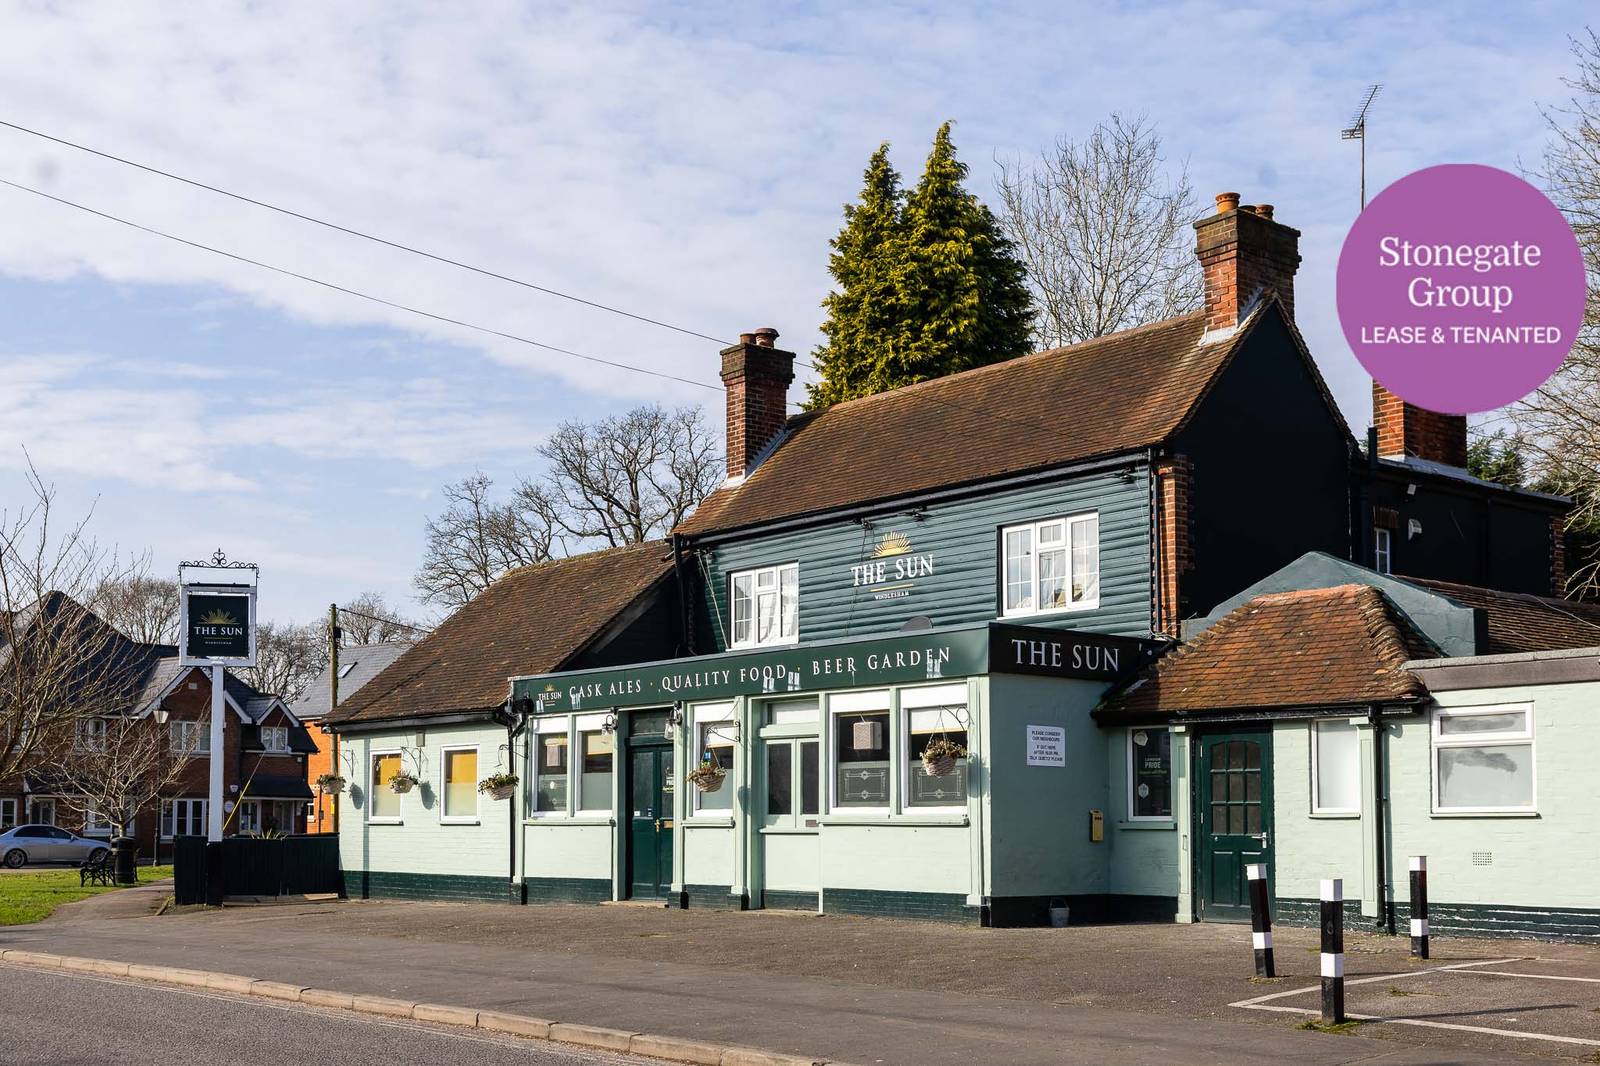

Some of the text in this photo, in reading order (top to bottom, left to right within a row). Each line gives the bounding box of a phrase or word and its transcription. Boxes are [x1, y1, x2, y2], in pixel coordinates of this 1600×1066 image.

[850, 554, 934, 586] THE SUN
[194, 626, 243, 636] THE SUN
[1012, 639, 1119, 672] THE SUN
[570, 647, 950, 698] CASK ALES QUALITY FOOD BEER GARDEN
[538, 691, 562, 700] THE SUN
